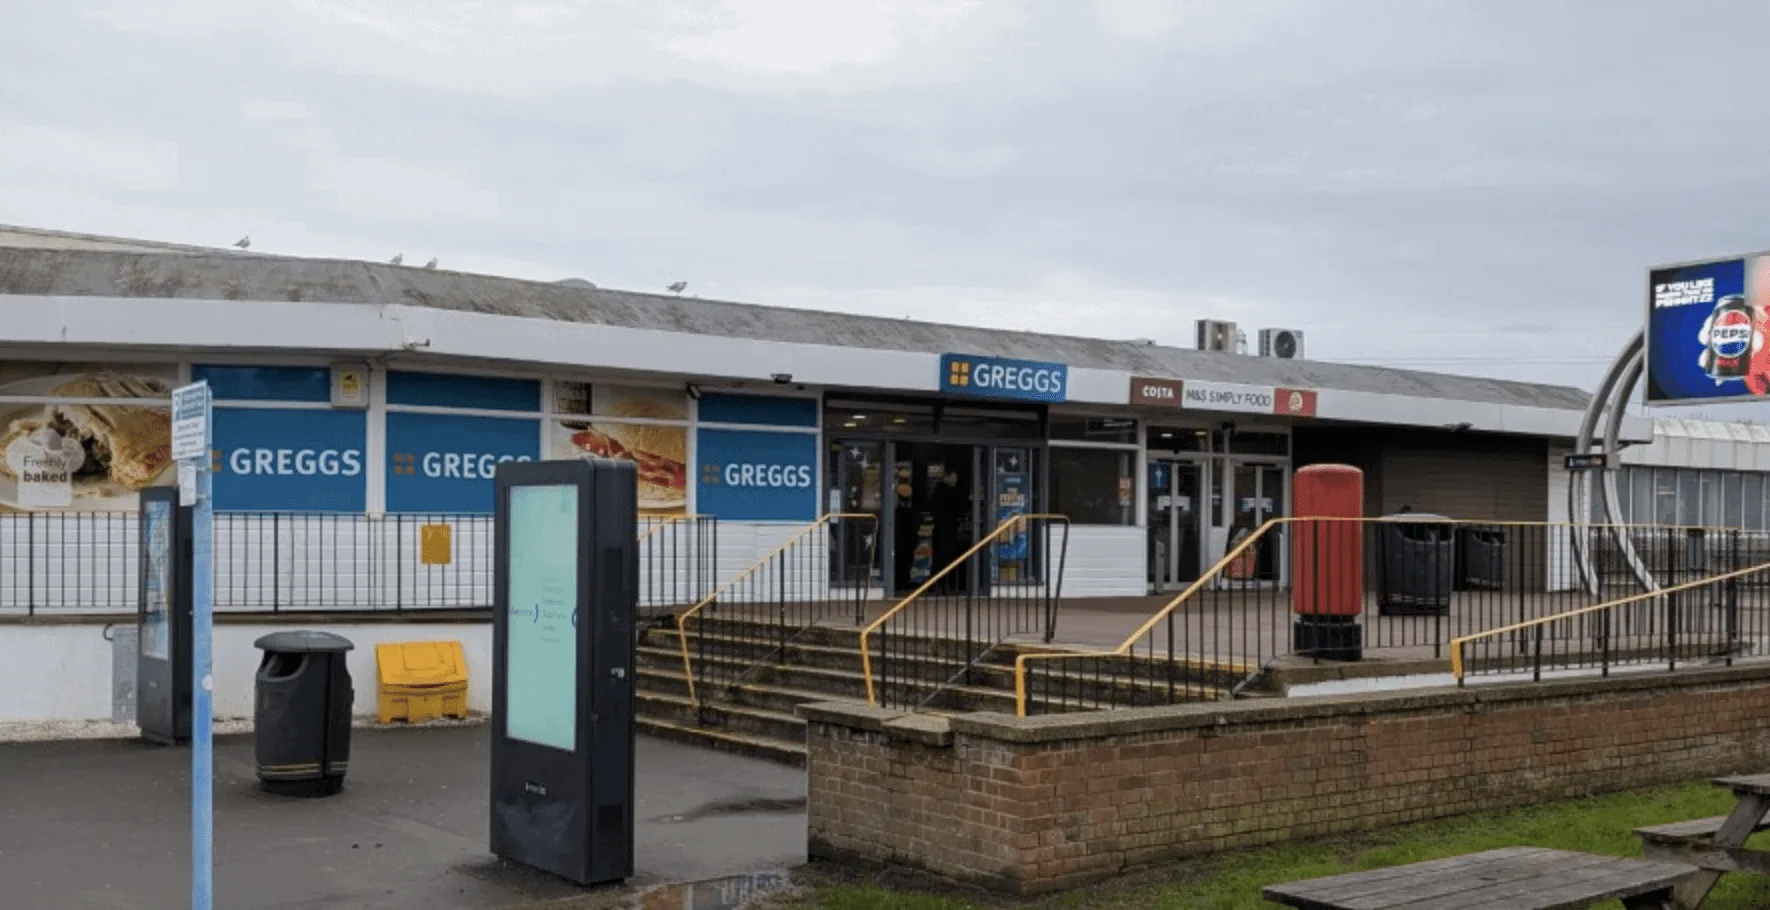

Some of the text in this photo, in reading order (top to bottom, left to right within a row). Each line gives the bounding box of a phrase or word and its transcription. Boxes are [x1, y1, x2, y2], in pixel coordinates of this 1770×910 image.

[973, 363, 1061, 393] GREGGS
[1142, 385, 1174, 399] COSTA
[1186, 388, 1271, 407] M&S SIMPLY FOOD
[230, 448, 361, 476] GREGGS
[423, 451, 531, 479] GREG
[24, 470, 67, 483] baked
[725, 463, 811, 487] GREGGS
